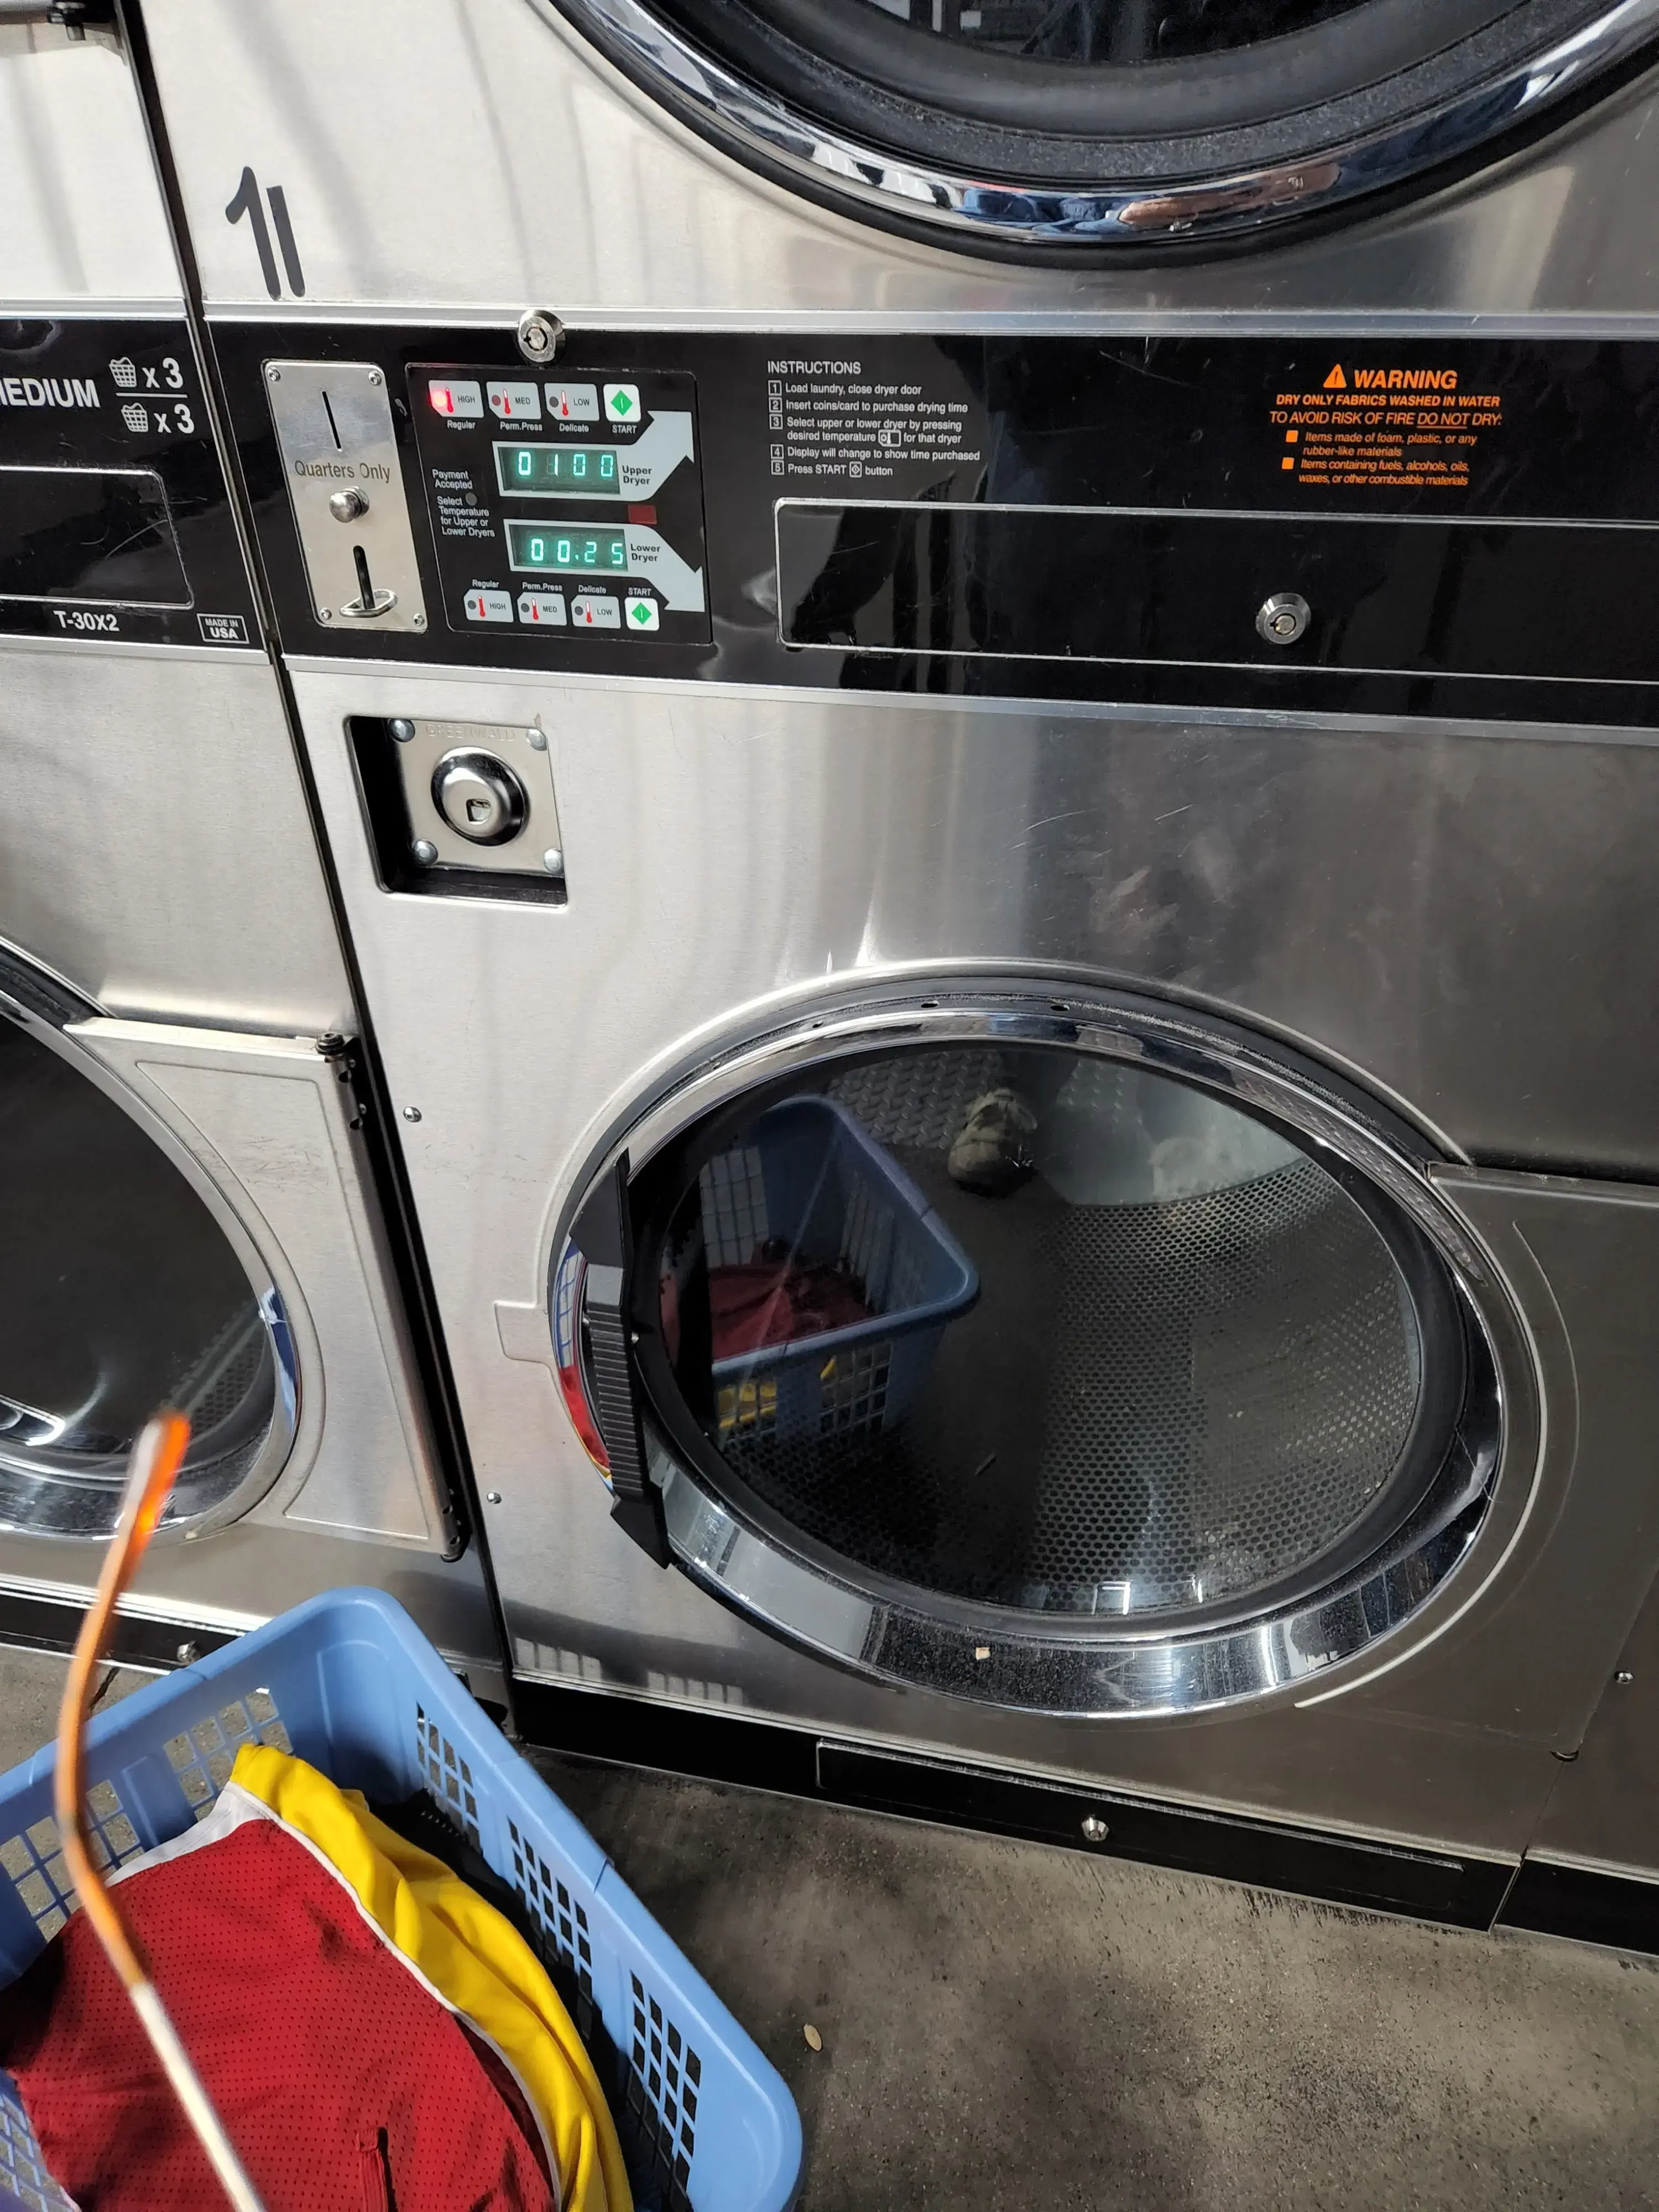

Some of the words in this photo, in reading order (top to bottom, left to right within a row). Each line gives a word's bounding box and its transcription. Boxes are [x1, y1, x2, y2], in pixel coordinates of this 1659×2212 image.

[225, 166, 306, 300] 11
[163, 357, 183, 389] 3
[768, 361, 861, 374] INSTRUCTIONS
[1354, 369, 1458, 389] WARNING
[785, 382, 807, 393] Load
[811, 383, 846, 396] laundry,
[848, 384, 872, 394] close
[874, 384, 898, 396] dryer
[900, 384, 922, 394] door
[573, 398, 590, 406] LOW
[1276, 394, 1301, 405] DRY
[1302, 394, 1334, 405] ONLY
[1335, 395, 1387, 405] FABRICS
[1390, 395, 1441, 406] WASHED
[1443, 396, 1455, 406] IN
[1458, 396, 1500, 407] WATER
[786, 400, 811, 409] Insert
[813, 400, 859, 411] coins/card
[862, 401, 870, 411] to
[873, 401, 915, 413] purchase
[917, 402, 946, 415] drying
[948, 402, 968, 413] time
[175, 404, 195, 434] 3
[787, 416, 815, 427] Select
[817, 419, 843, 429] upper
[857, 418, 881, 429] lower
[884, 418, 907, 430] dryer
[909, 419, 921, 431] by
[922, 420, 962, 432] pressing
[1270, 411, 1287, 423] TO
[1289, 411, 1329, 424] AVOID
[1332, 412, 1363, 424] RISK
[1365, 412, 1384, 424] OF
[1385, 413, 1416, 425] FIRE
[1417, 413, 1438, 425] DO
[1441, 413, 1471, 425] NOT
[1472, 413, 1503, 426] DRY:
[447, 420, 476, 431] Regular
[500, 422, 542, 432] Perm.Press
[559, 423, 589, 433] Delicate
[612, 425, 637, 434] START
[787, 430, 820, 440] desired
[822, 431, 876, 443] temperature
[903, 432, 916, 442] for
[919, 433, 936, 443] that
[937, 434, 962, 446] dryer
[1305, 432, 1332, 442] Items
[1334, 432, 1363, 442] made
[1365, 432, 1376, 442] of
[1445, 434, 1457, 444] or
[1458, 435, 1478, 446] any
[787, 446, 820, 459] Display
[822, 448, 836, 457] will
[838, 448, 871, 460] change
[873, 449, 882, 458] to
[885, 449, 908, 459] show
[911, 450, 930, 460] time
[932, 450, 980, 462] purchased
[1303, 445, 1354, 456] rubber-like
[1357, 446, 1402, 456] materials
[294, 460, 354, 479] Quarters
[359, 462, 390, 484] Only
[622, 465, 652, 476] Upper
[788, 463, 813, 474] Press
[816, 464, 847, 474] START
[865, 465, 893, 476] button
[1301, 459, 1327, 469] Items
[1329, 460, 1377, 472] containing
[432, 469, 469, 481] Payment
[623, 476, 650, 486] Dryer
[1343, 474, 1368, 483] other
[1369, 474, 1424, 484] combustible
[1426, 475, 1468, 486] materials
[435, 479, 473, 491] Accepted
[437, 495, 463, 506] Select
[438, 505, 489, 517] Temperature
[440, 516, 452, 525] for
[453, 516, 478, 528] Upper
[441, 526, 466, 536] Lower
[468, 527, 495, 539] Dryers
[630, 544, 661, 553] Lower
[631, 553, 659, 564] Dryer
[472, 579, 499, 589] Regular
[522, 582, 563, 592] Perm.Press
[578, 585, 607, 594] Delicate
[628, 588, 651, 596] START
[489, 602, 506, 611] HIGH
[53, 610, 120, 632] T-30X2
[205, 618, 225, 628] MADE
[227, 619, 238, 628] IN
[210, 627, 239, 639] USA
